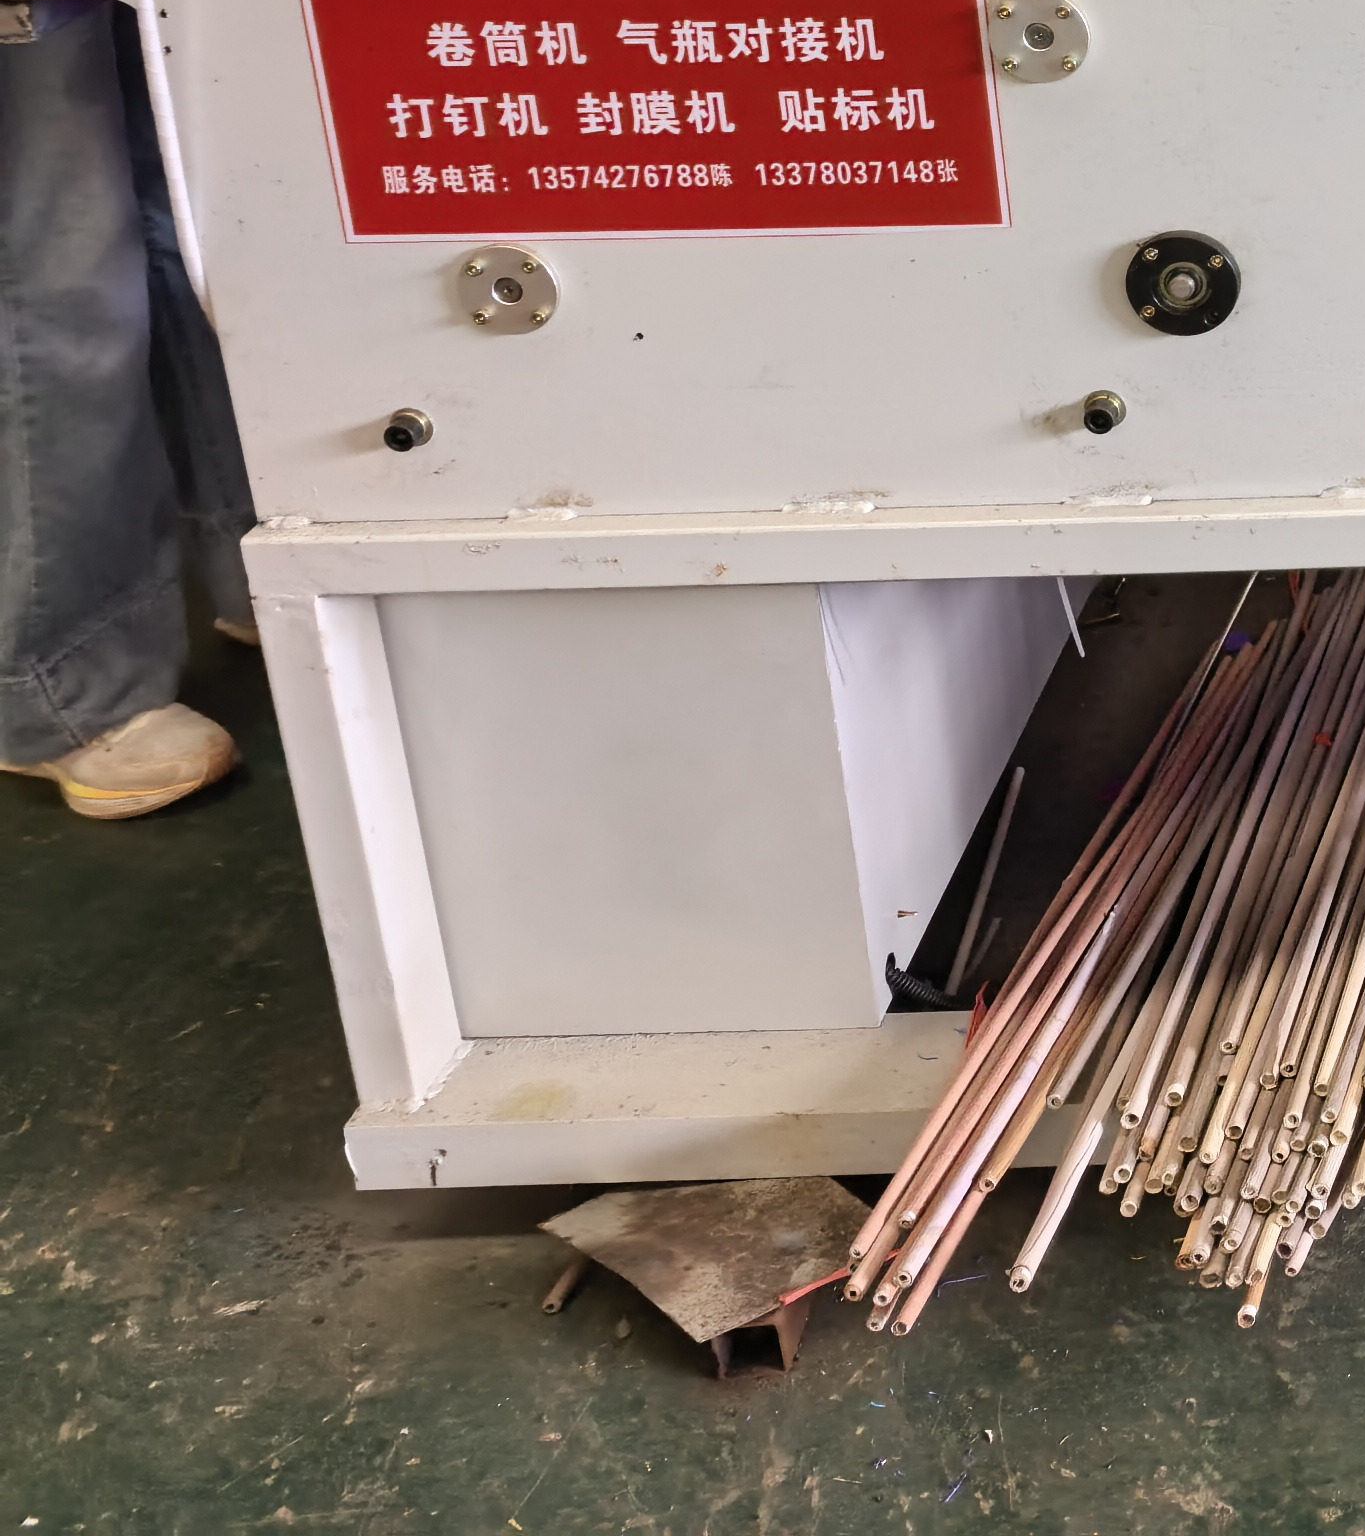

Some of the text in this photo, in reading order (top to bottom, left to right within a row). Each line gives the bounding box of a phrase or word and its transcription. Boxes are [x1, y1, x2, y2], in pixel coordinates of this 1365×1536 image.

[427, 17, 884, 66] 卷筒机 气瓶对接机
[387, 88, 934, 138] 打钉机 封膜机 贴标机
